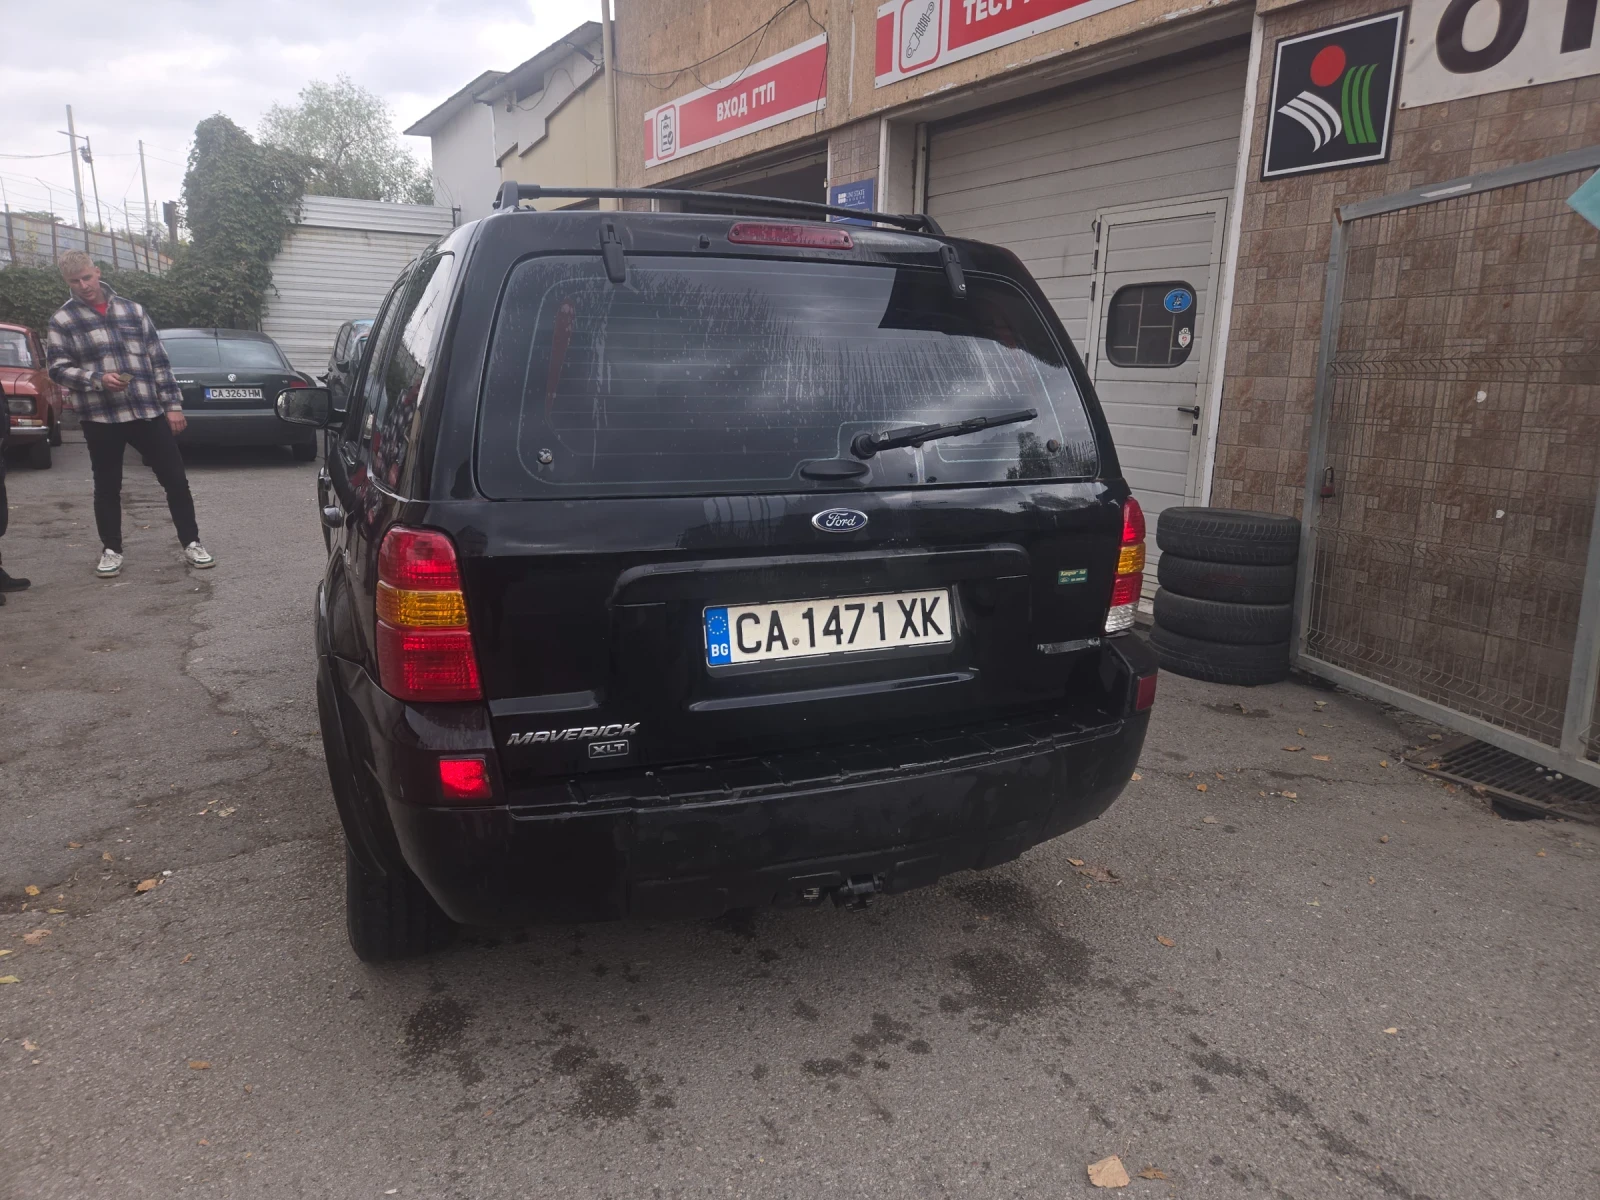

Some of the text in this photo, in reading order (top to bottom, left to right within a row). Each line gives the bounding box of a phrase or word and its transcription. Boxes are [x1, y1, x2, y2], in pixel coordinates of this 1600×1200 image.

[717, 81, 775, 122] ВХОД ГТП
[211, 389, 223, 398] CA
[225, 389, 247, 398] 3263
[248, 389, 260, 398] HM
[826, 512, 856, 527] Ford
[736, 596, 944, 654] CA 1471 XK
[711, 643, 729, 657] BG
[506, 722, 640, 746] MAVERICK
[592, 743, 625, 755] XLT
